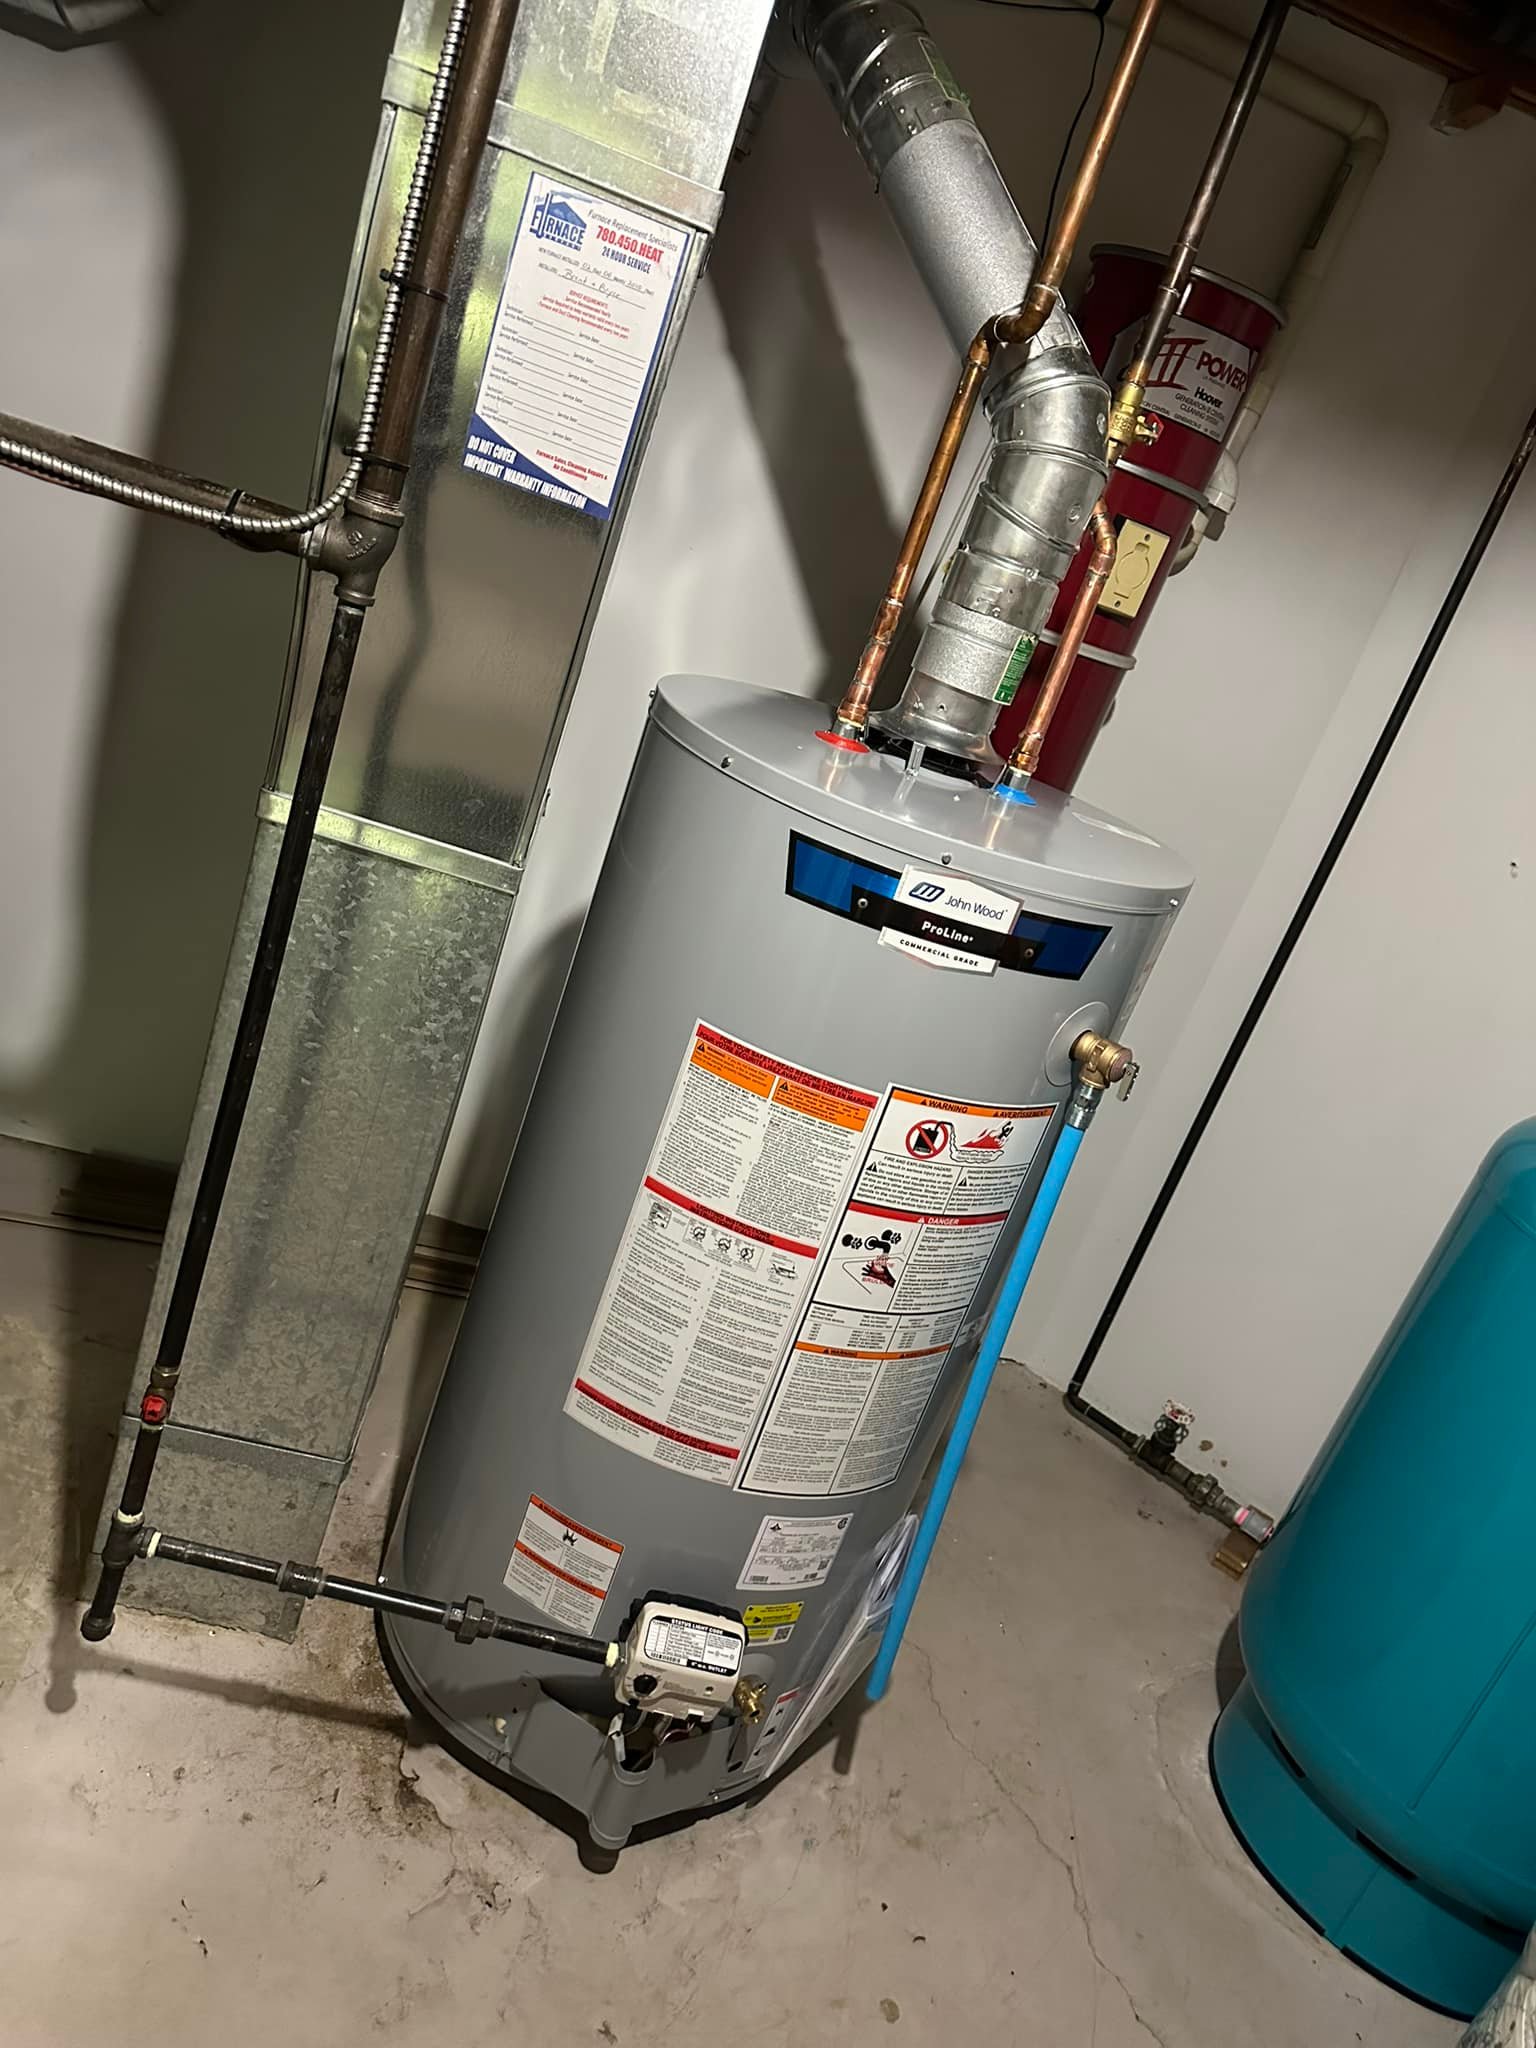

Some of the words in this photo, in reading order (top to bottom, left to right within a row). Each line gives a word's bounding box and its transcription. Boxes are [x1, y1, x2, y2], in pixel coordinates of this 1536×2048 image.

[587, 208, 611, 225] Furnace
[611, 218, 648, 240] Replacement
[647, 232, 678, 252] Specialists
[595, 225, 664, 263] 780.450.HEAT
[601, 246, 610, 258] 24
[609, 249, 627, 264] HOUR
[626, 255, 651, 274] SERVICE
[1196, 351, 1249, 392] POWER
[467, 435, 481, 451] DO
[480, 438, 497, 458] NOT
[493, 443, 517, 464] COVER
[463, 454, 505, 479] IMPORTANT
[503, 466, 544, 493] WARRANTY
[541, 477, 588, 509] INFORMATION
[944, 894, 972, 911] John
[972, 902, 1004, 921] Wood
[920, 920, 969, 944] ProLine
[899, 938, 950, 959] COMMERCIAL
[953, 954, 979, 967] GRADE
[731, 1042, 750, 1054] YOUR
[750, 1050, 777, 1066] SAFETY
[821, 1077, 854, 1096] LIGHTING
[928, 1100, 968, 1113] WARNING
[927, 1217, 960, 1226] DANGER
[670, 1618, 691, 1628] STATUS
[691, 1623, 708, 1631] LIGHT
[708, 1627, 723, 1635] CODE
[707, 1664, 727, 1674] OUTLET
